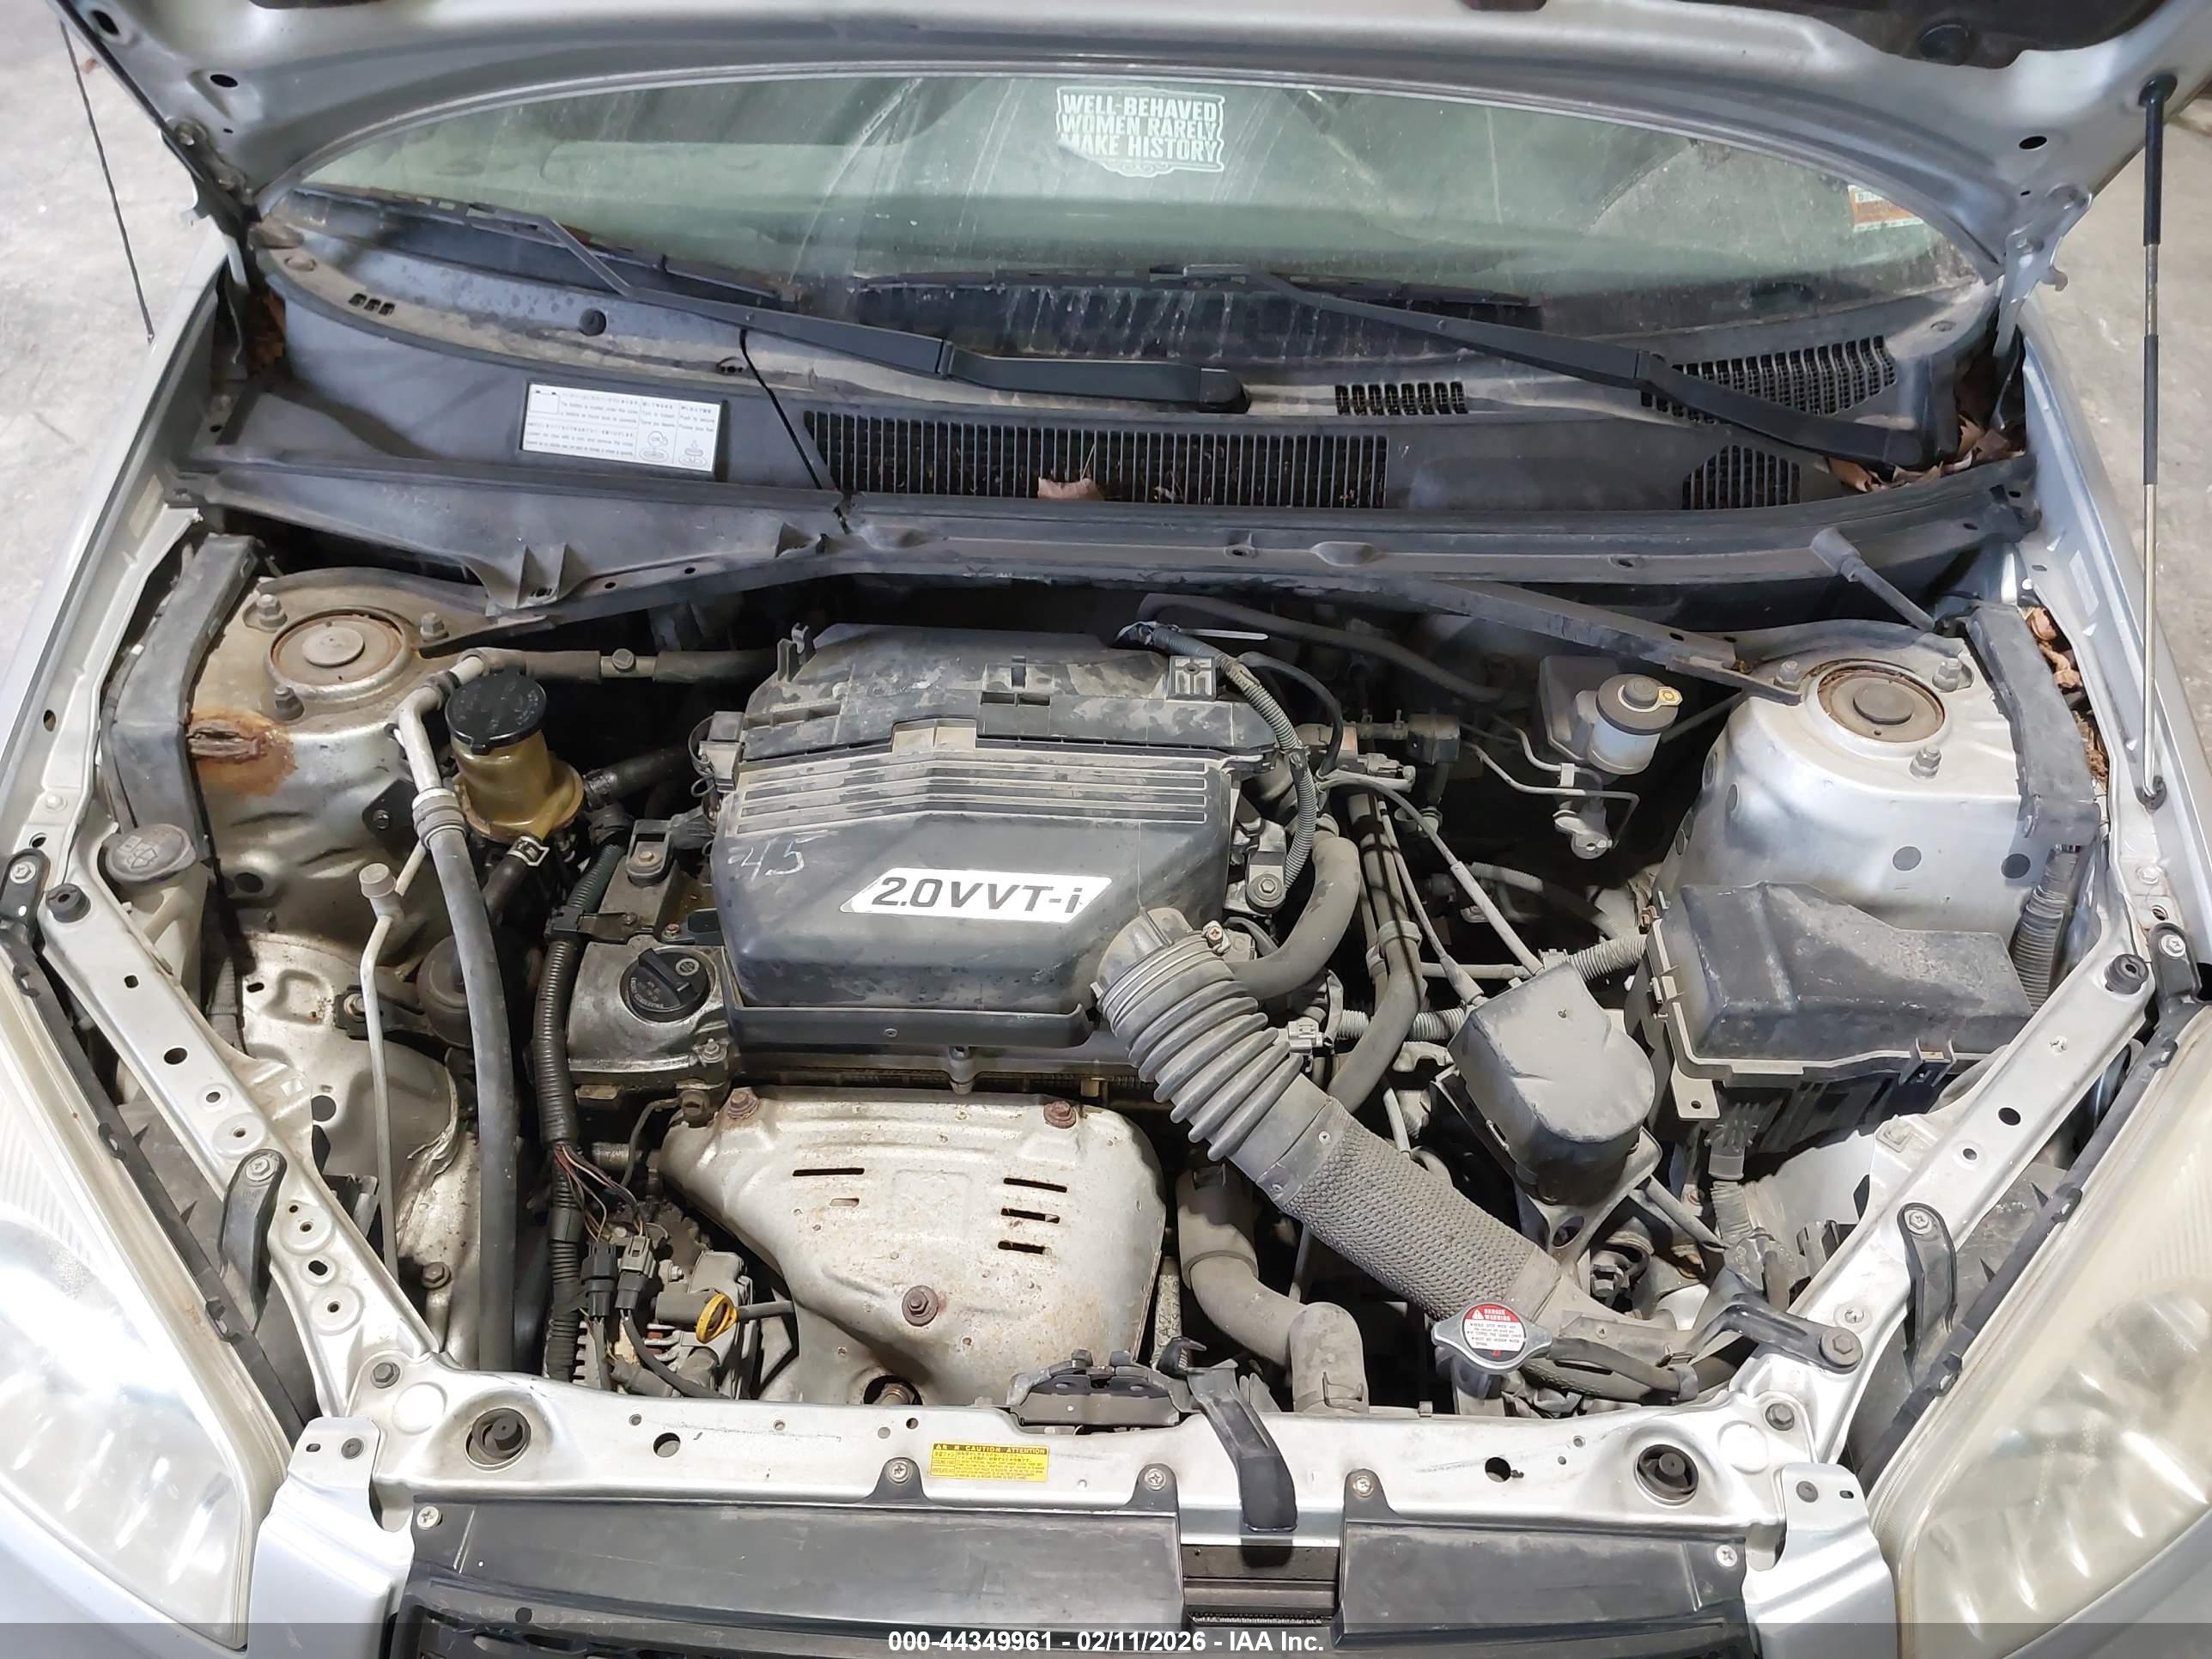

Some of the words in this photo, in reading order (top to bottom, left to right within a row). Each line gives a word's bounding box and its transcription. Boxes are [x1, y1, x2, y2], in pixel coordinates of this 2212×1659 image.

[1063, 94, 1217, 121] WELL-BEHAVED
[1062, 113, 1140, 136] WOMEN
[1147, 117, 1217, 141] RARELY
[1127, 136, 1217, 161] HISTORY
